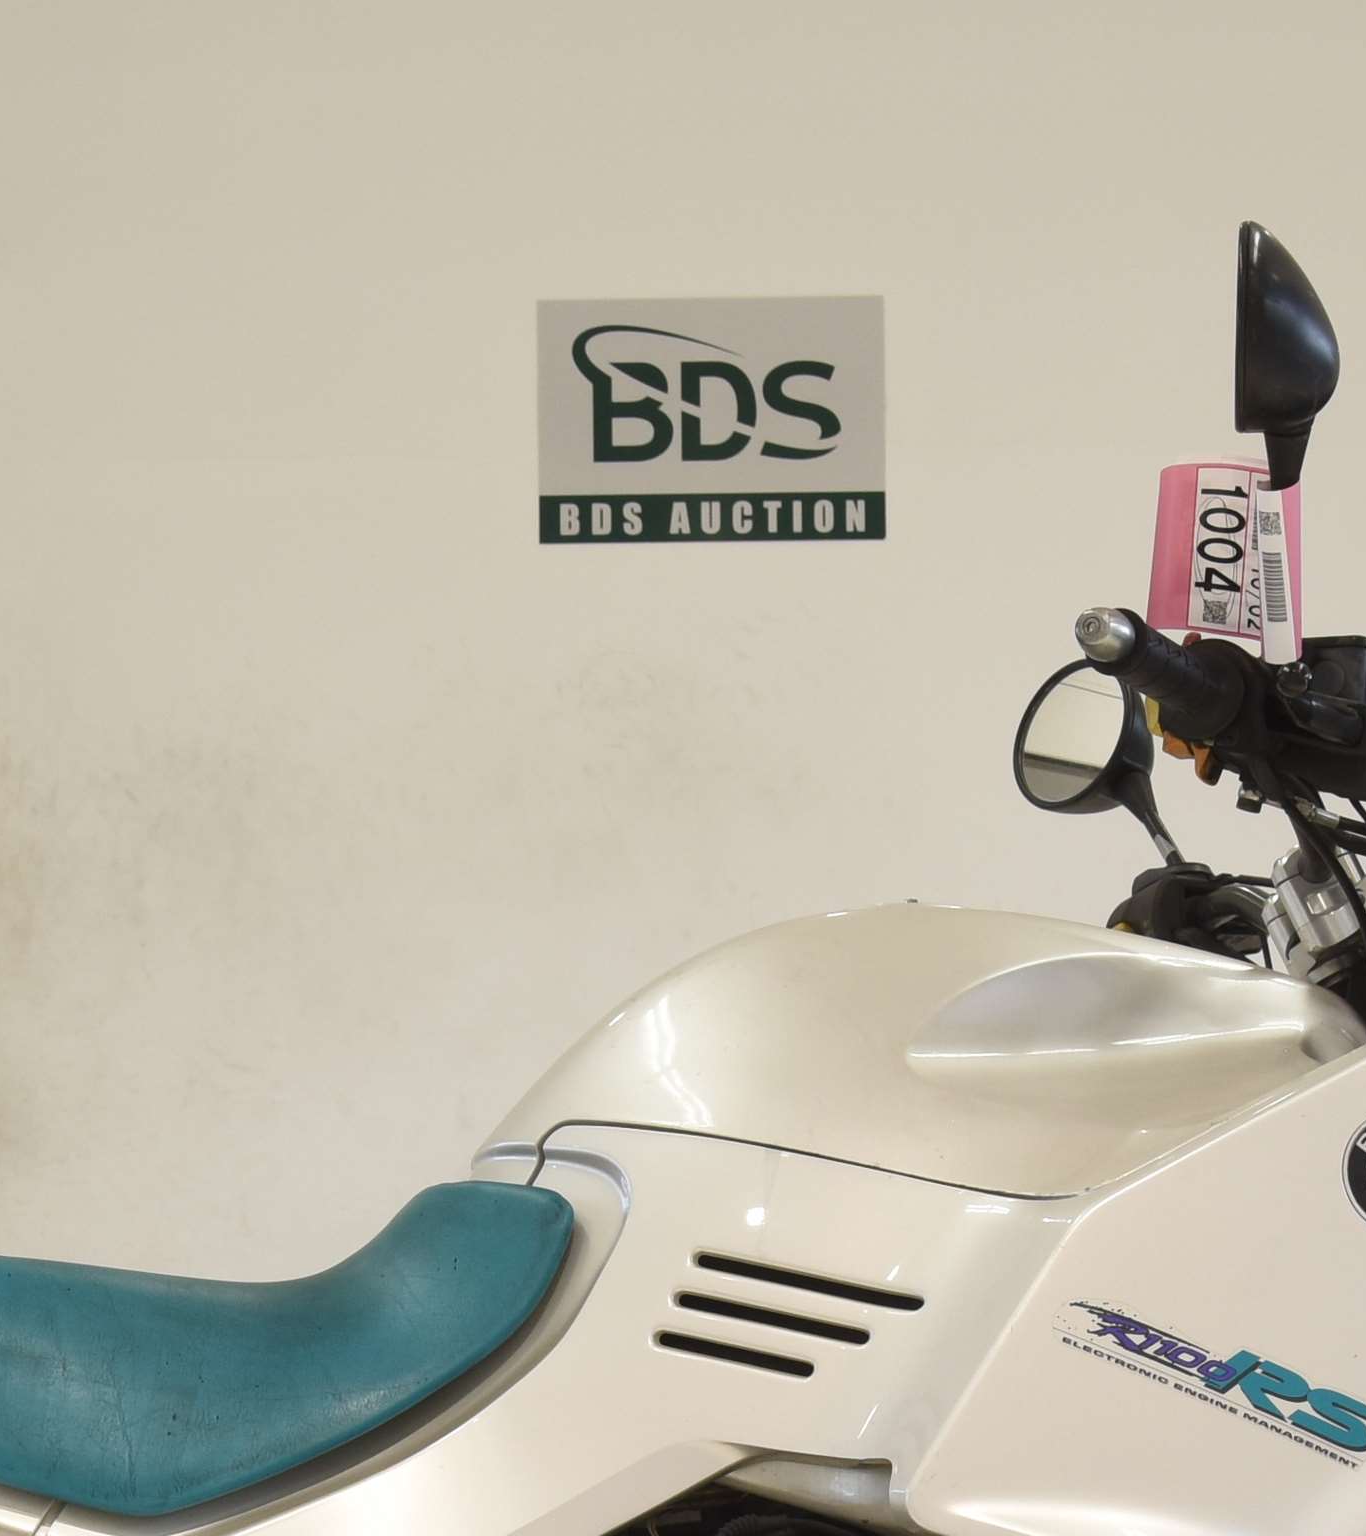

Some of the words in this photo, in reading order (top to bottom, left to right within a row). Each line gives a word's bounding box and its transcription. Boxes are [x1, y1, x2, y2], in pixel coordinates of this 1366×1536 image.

[573, 327, 841, 462] BDS
[559, 502, 644, 536] BDS
[669, 499, 867, 535] AUCTION
[1195, 486, 1249, 592] 1004
[1062, 1336, 1170, 1385] ELECTRONIC
[1173, 1382, 1239, 1415] ENGINE
[1243, 1412, 1359, 1470] MANAGEMENT
